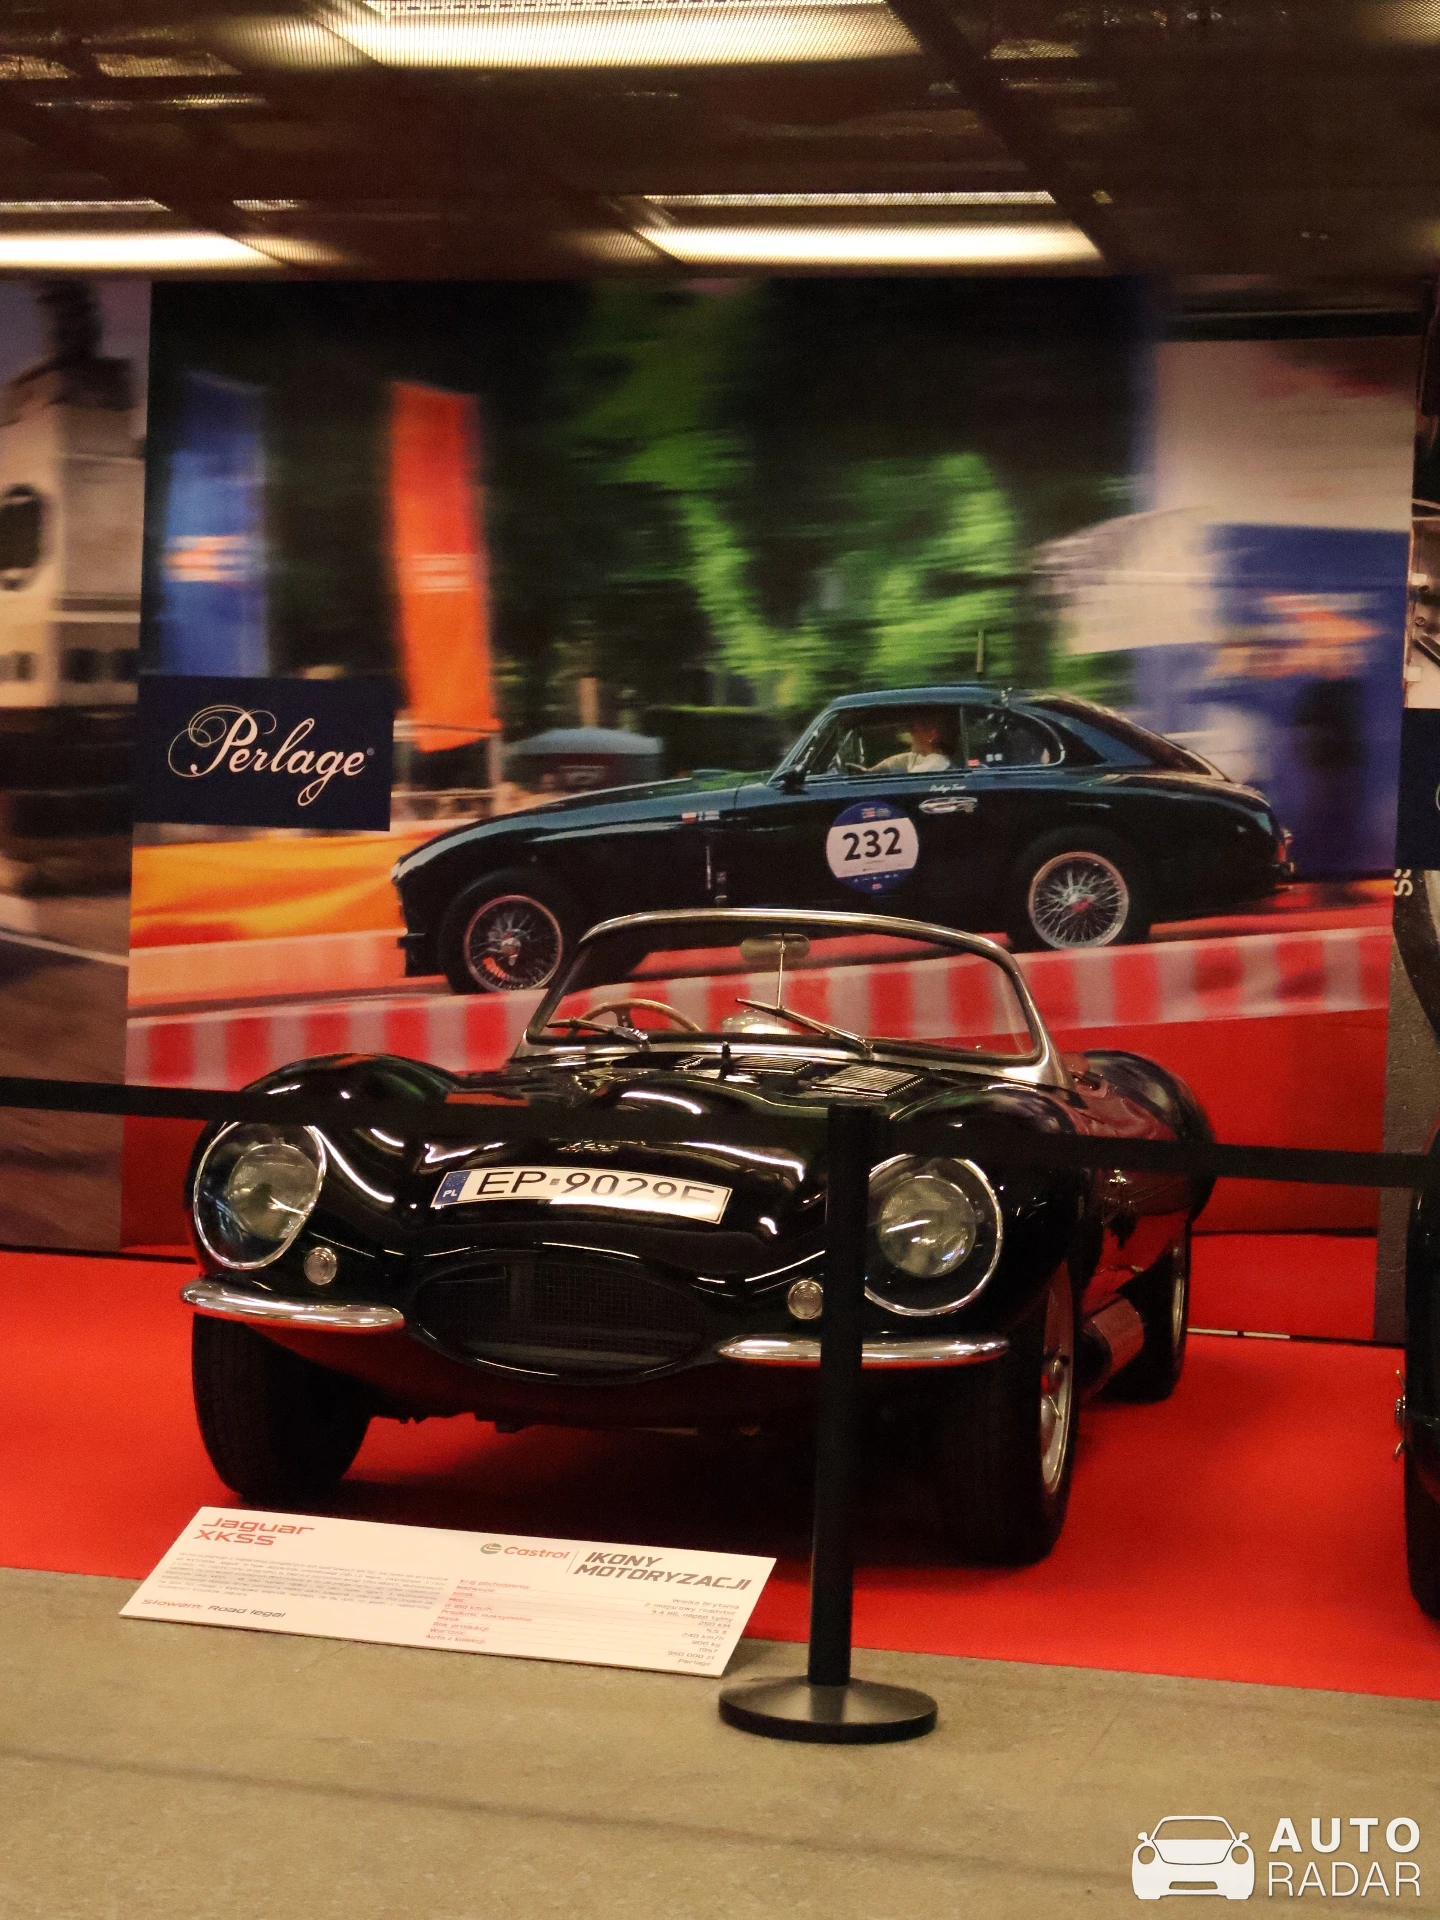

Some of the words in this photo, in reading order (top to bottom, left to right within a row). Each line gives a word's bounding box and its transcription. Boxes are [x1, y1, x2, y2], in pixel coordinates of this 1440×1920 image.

[168, 704, 366, 807] Perlage
[842, 827, 902, 861] 232
[476, 1171, 547, 1196] EP
[442, 1188, 457, 1198] PL
[201, 1517, 315, 1535] Jaguar
[193, 1529, 277, 1546] XKSS
[503, 1545, 571, 1560] Castrol
[584, 1551, 664, 1568] IKONY
[573, 1564, 753, 1591] MOTORYZACJI
[207, 1604, 248, 1615] Road
[249, 1608, 287, 1619] legal
